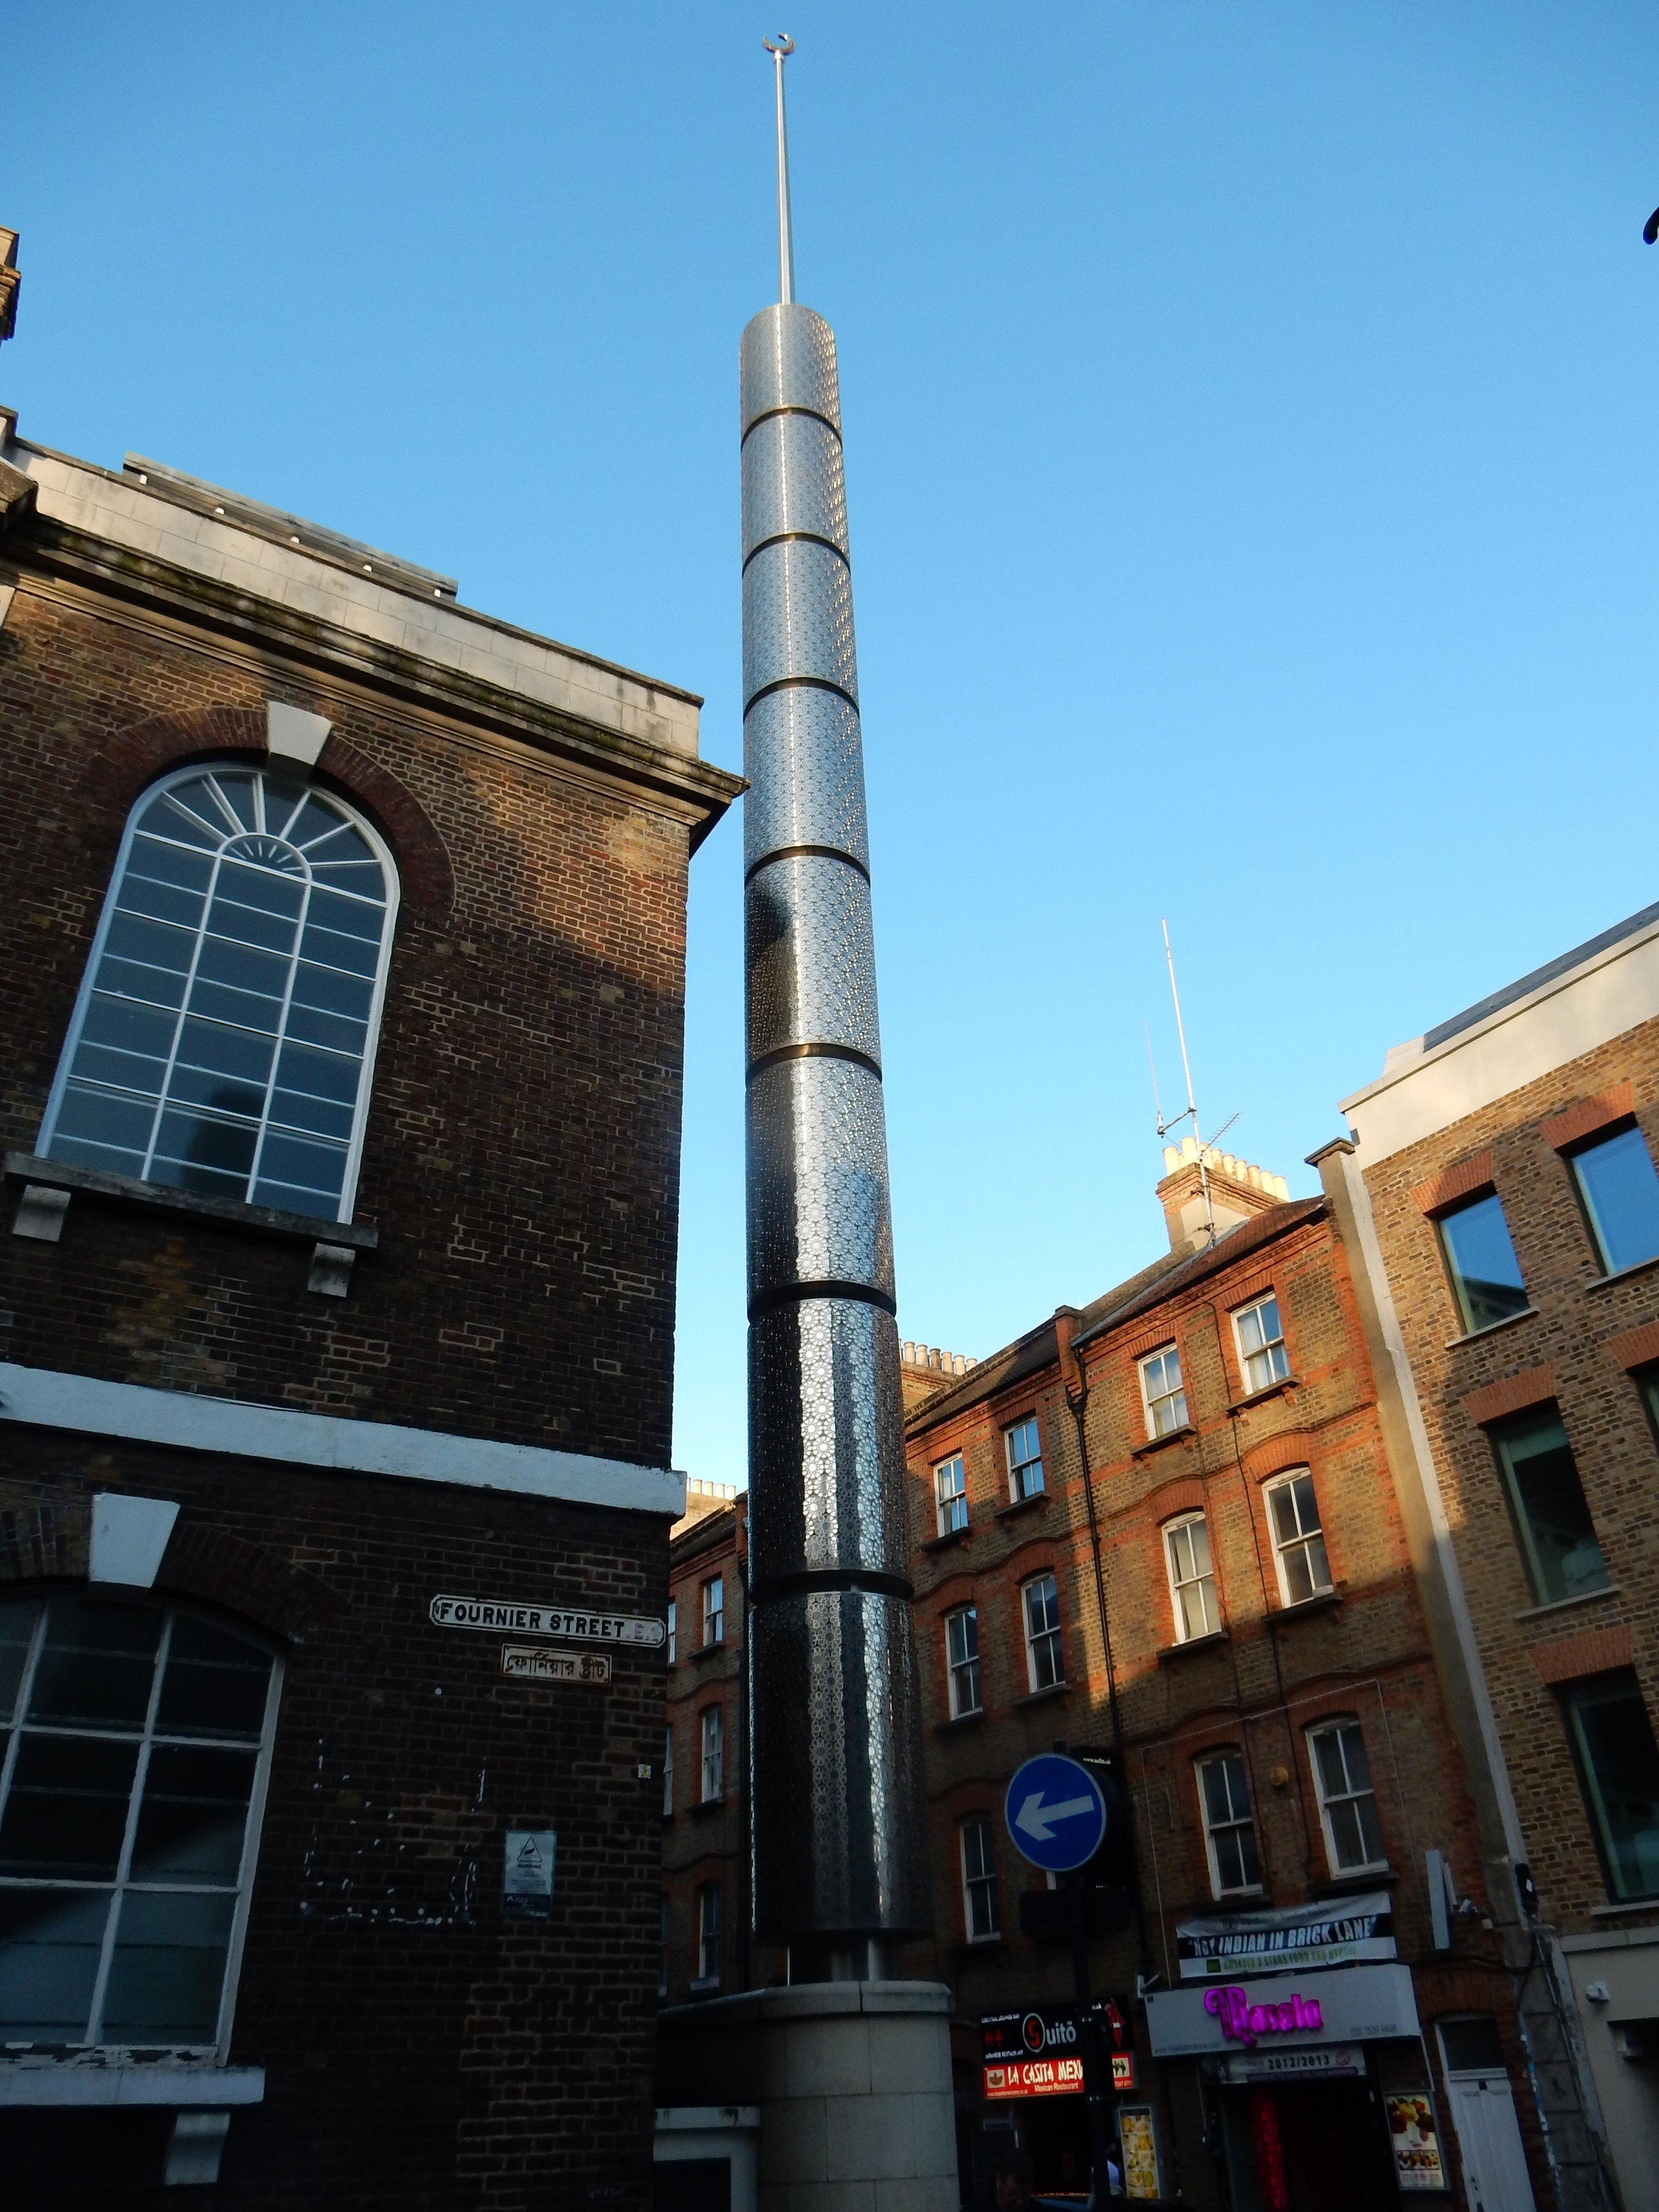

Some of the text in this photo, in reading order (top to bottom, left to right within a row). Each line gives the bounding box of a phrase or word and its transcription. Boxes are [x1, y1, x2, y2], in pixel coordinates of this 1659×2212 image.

[440, 1601, 541, 1629] FOURNIER
[549, 1613, 625, 1637] STREET
[1219, 1933, 1265, 1954] INDIAN
[1269, 1930, 1283, 1949] IN
[1287, 1923, 1333, 1947] BRICK
[1204, 1986, 1324, 2047] Masala
[1007, 2059, 1083, 2086] LA CASITA MEXI
[1268, 2054, 1330, 2069] 2012/2013
[1054, 2082, 1079, 2091] Restaurant
